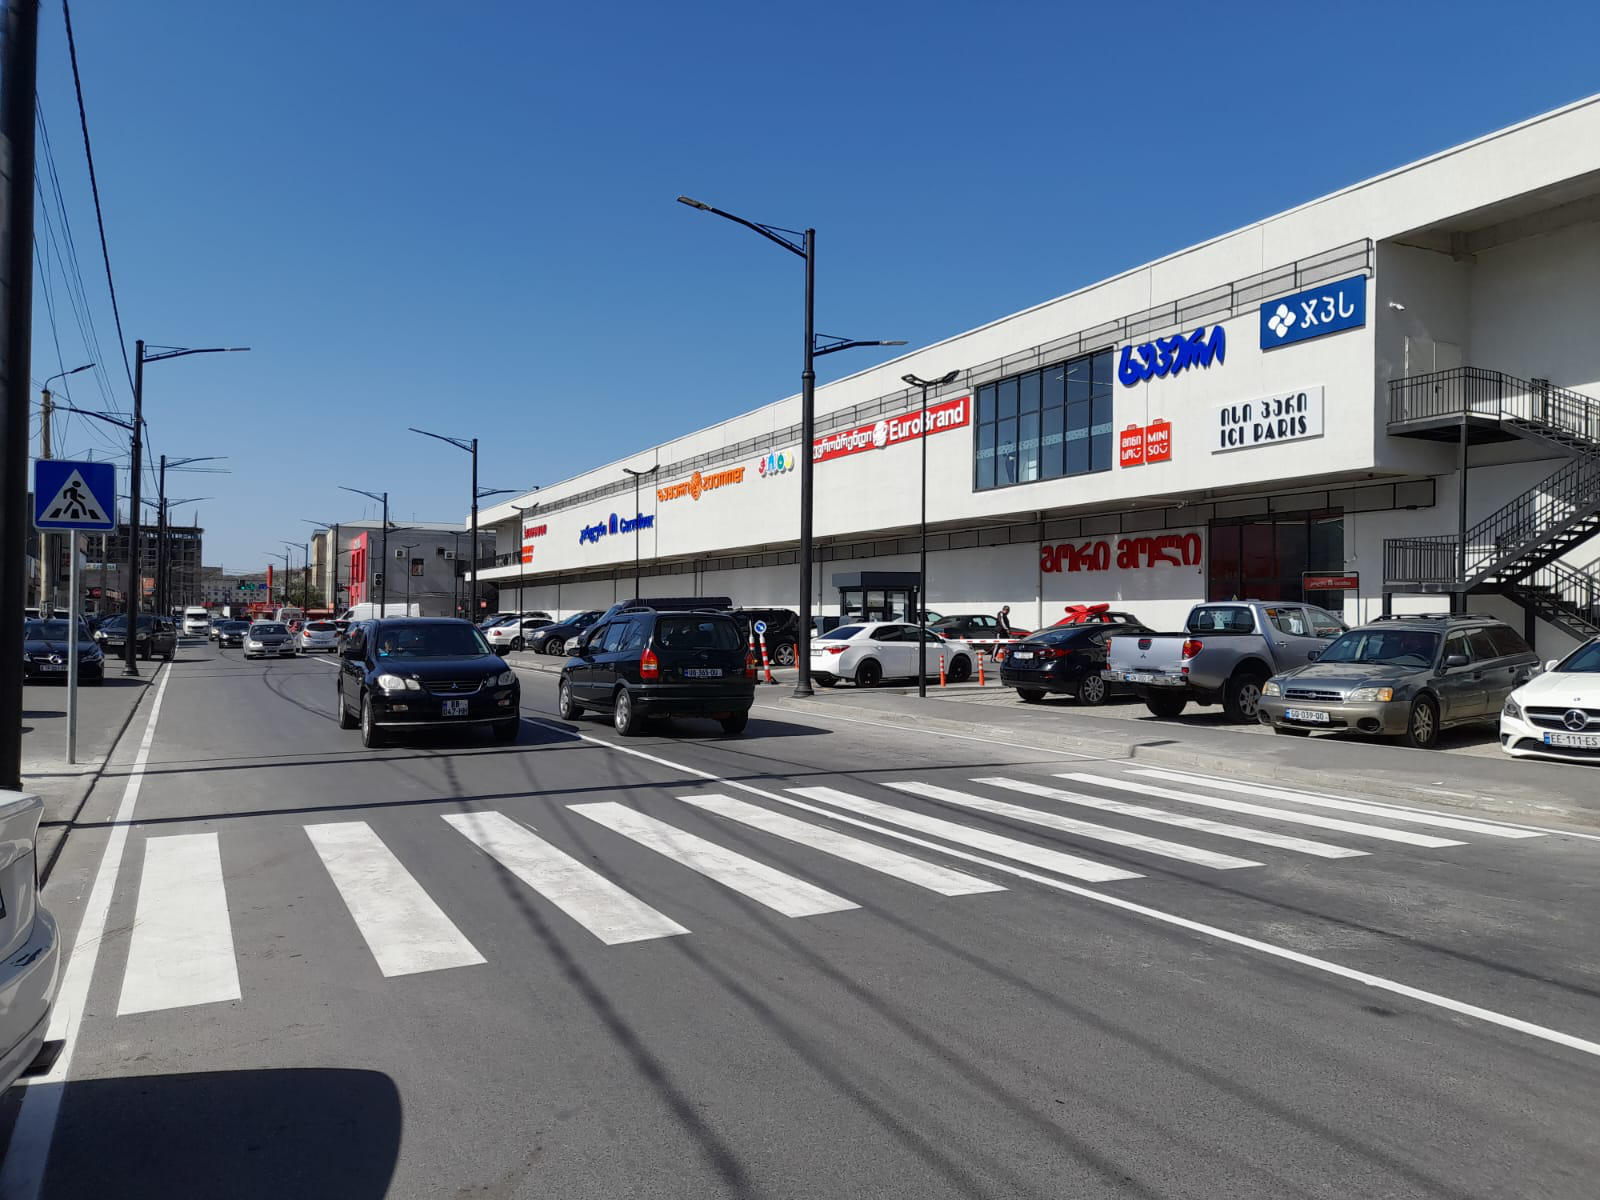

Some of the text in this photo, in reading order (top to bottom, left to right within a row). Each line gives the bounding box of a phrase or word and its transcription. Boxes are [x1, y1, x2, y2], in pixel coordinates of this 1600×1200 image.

[889, 401, 964, 441] EuroBrand
[1220, 404, 1252, 427] ისი
[1220, 415, 1307, 448] ICI PARIS
[1147, 430, 1169, 443] MINI
[1040, 533, 1202, 573] გორი მოლი
